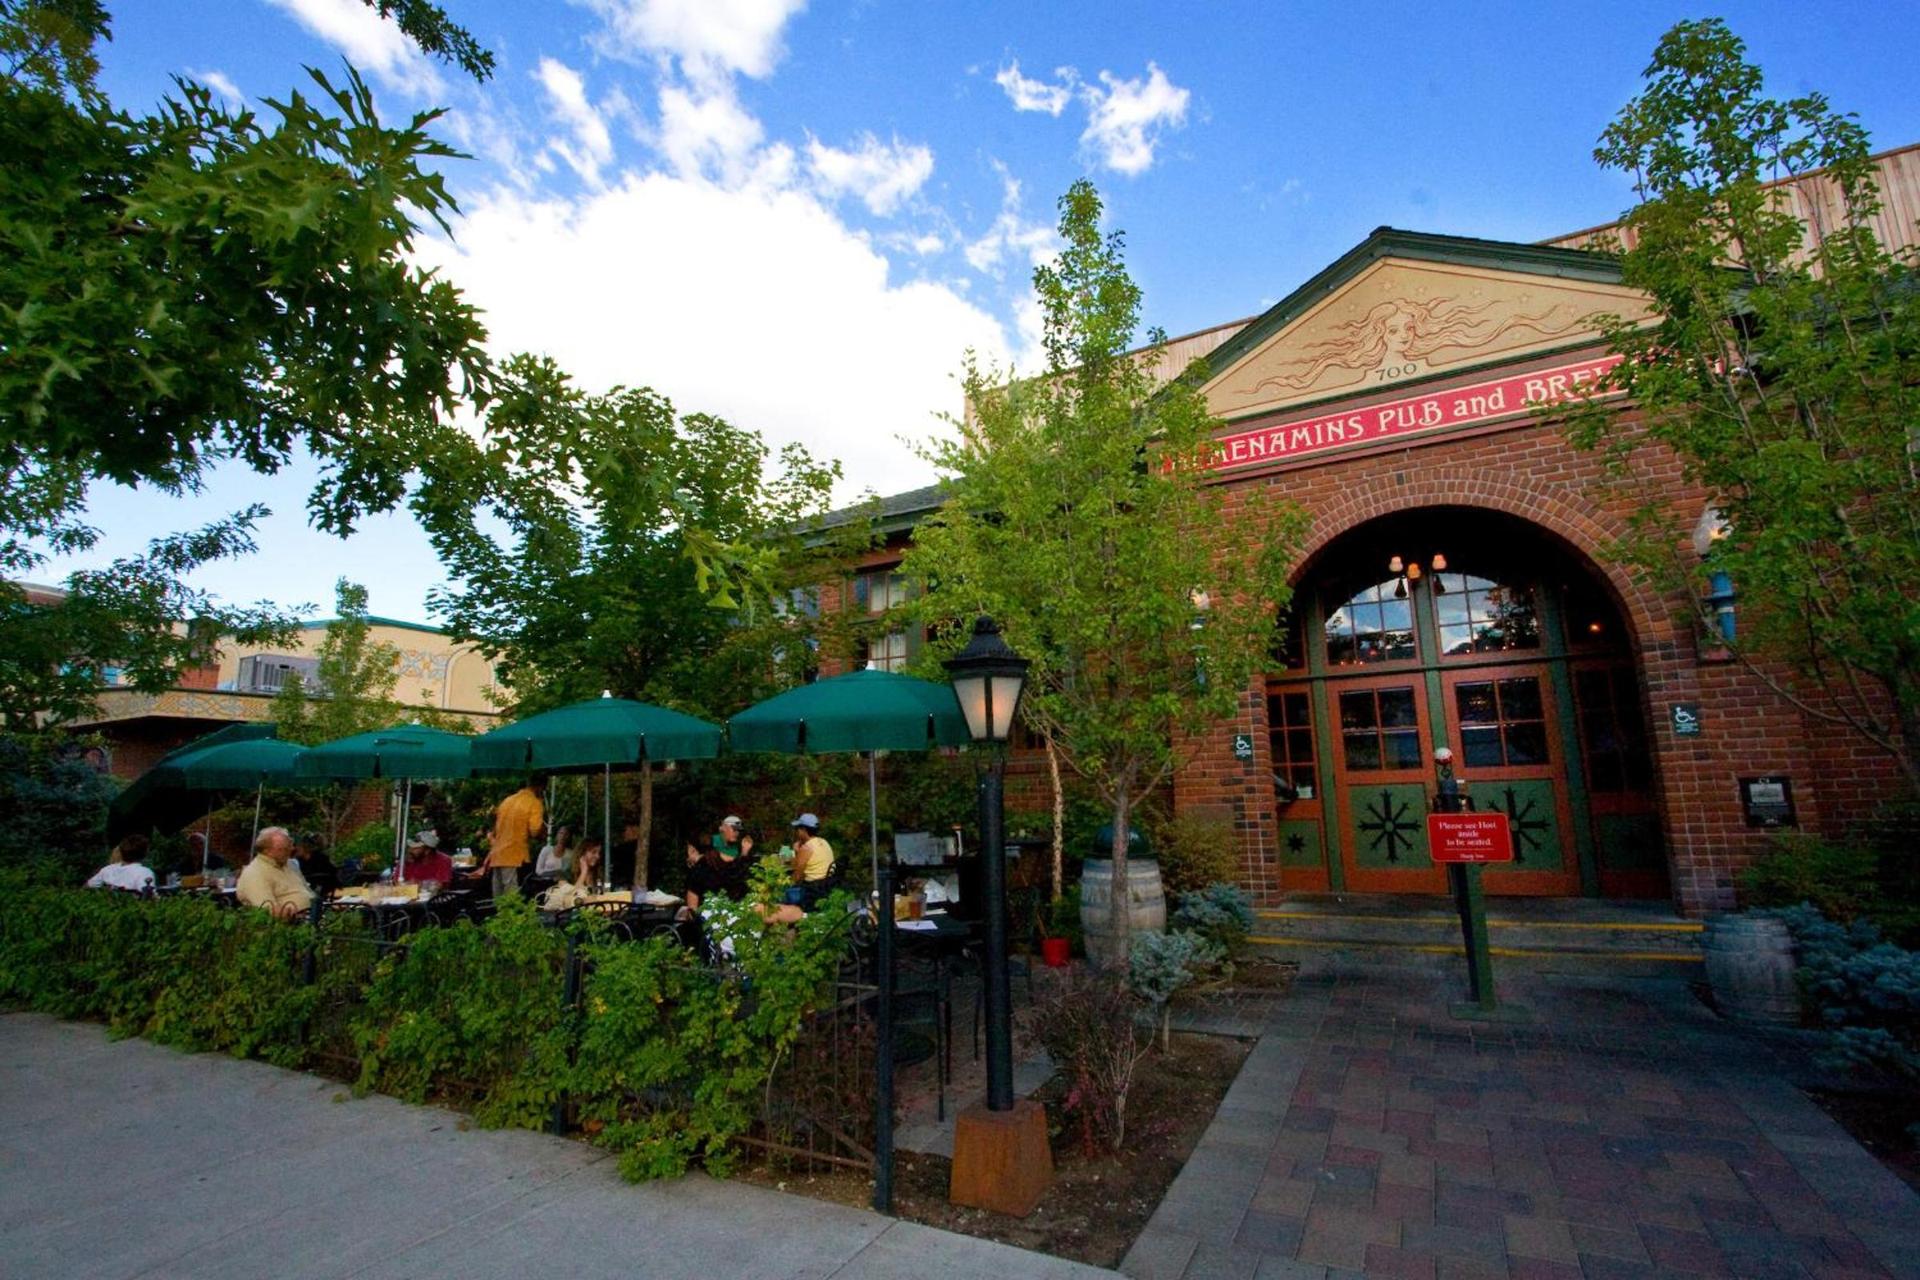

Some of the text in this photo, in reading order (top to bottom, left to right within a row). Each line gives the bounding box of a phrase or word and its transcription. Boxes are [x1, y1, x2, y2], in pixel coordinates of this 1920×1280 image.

[1375, 363, 1417, 381] 700
[1378, 400, 1442, 432] PUB
[1453, 387, 1505, 416] and
